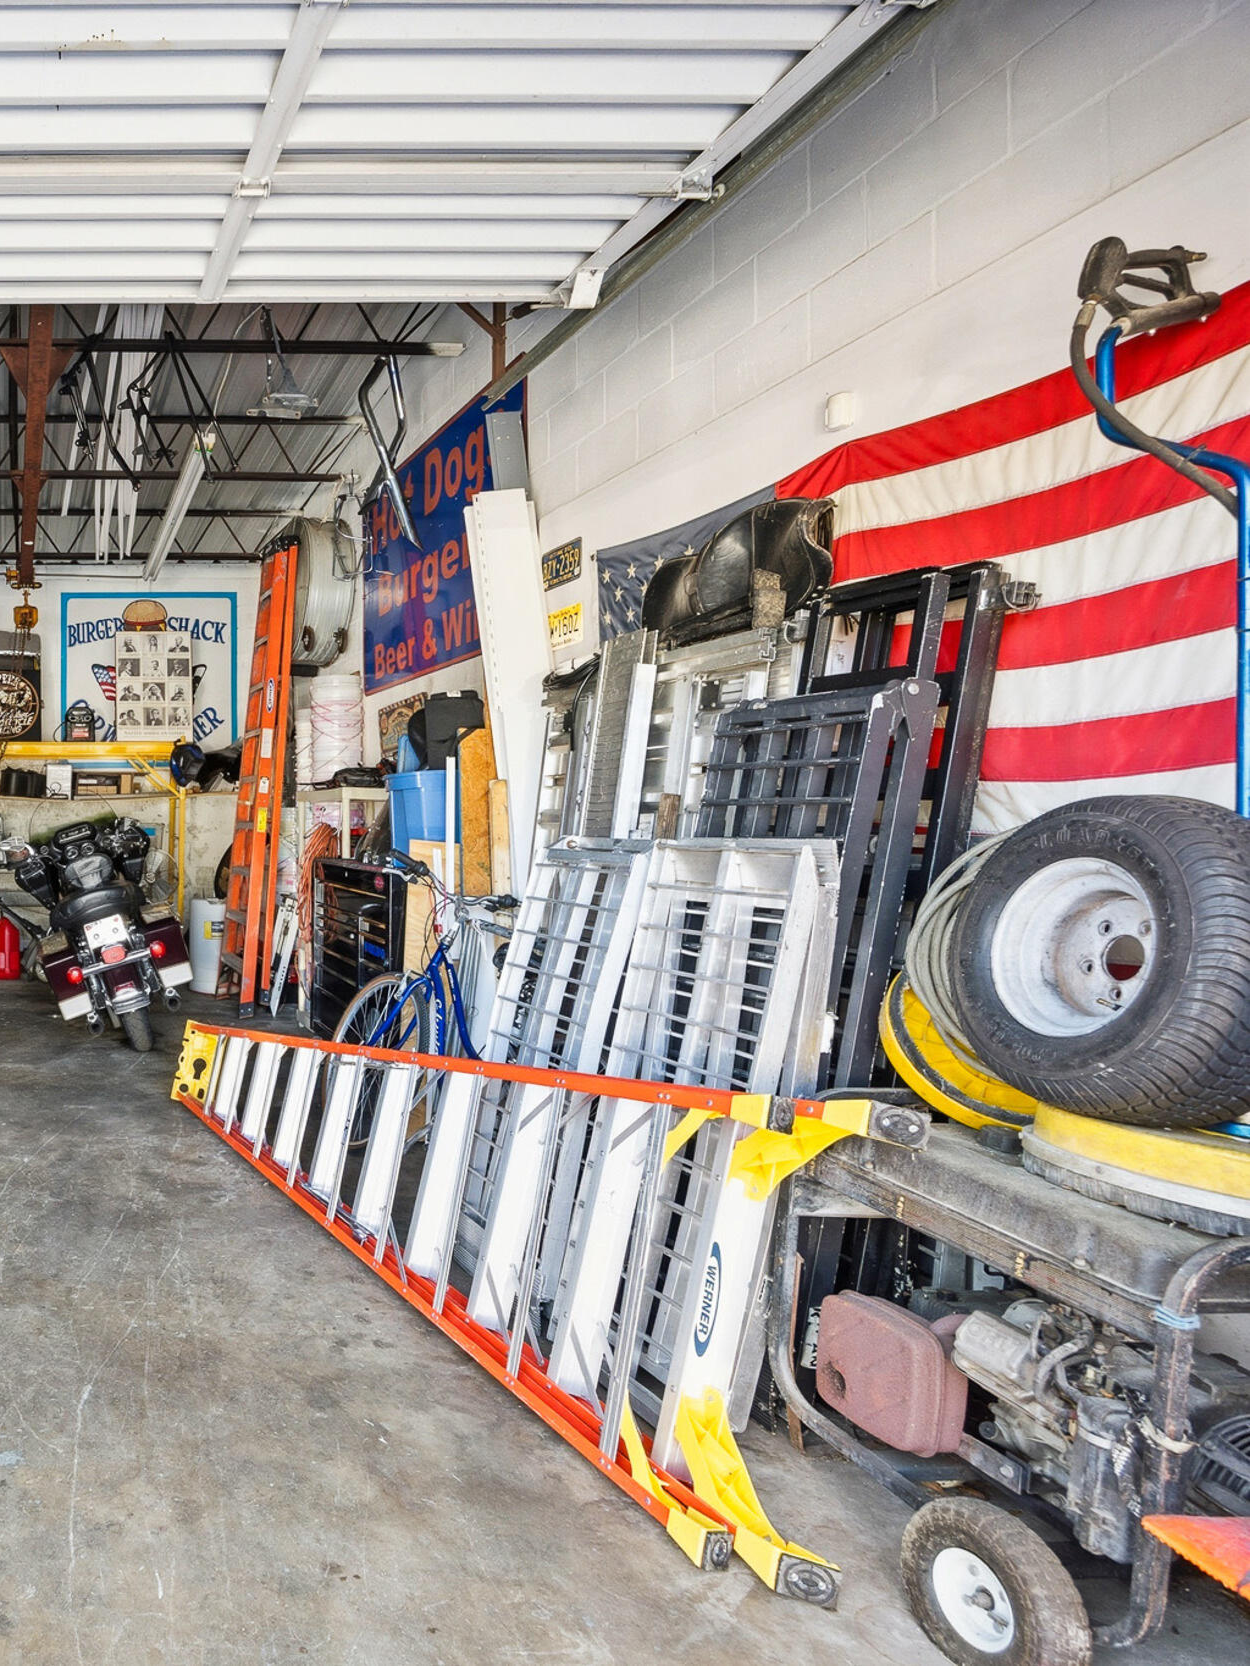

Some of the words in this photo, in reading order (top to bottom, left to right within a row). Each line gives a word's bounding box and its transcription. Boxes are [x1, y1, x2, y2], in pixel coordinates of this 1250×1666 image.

[424, 425, 491, 516] Dog
[68, 617, 125, 647] BURGER
[168, 616, 227, 644] SHACK
[374, 636, 416, 680] Beer
[422, 618, 437, 660] &
[698, 1265, 717, 1335] WERNER
